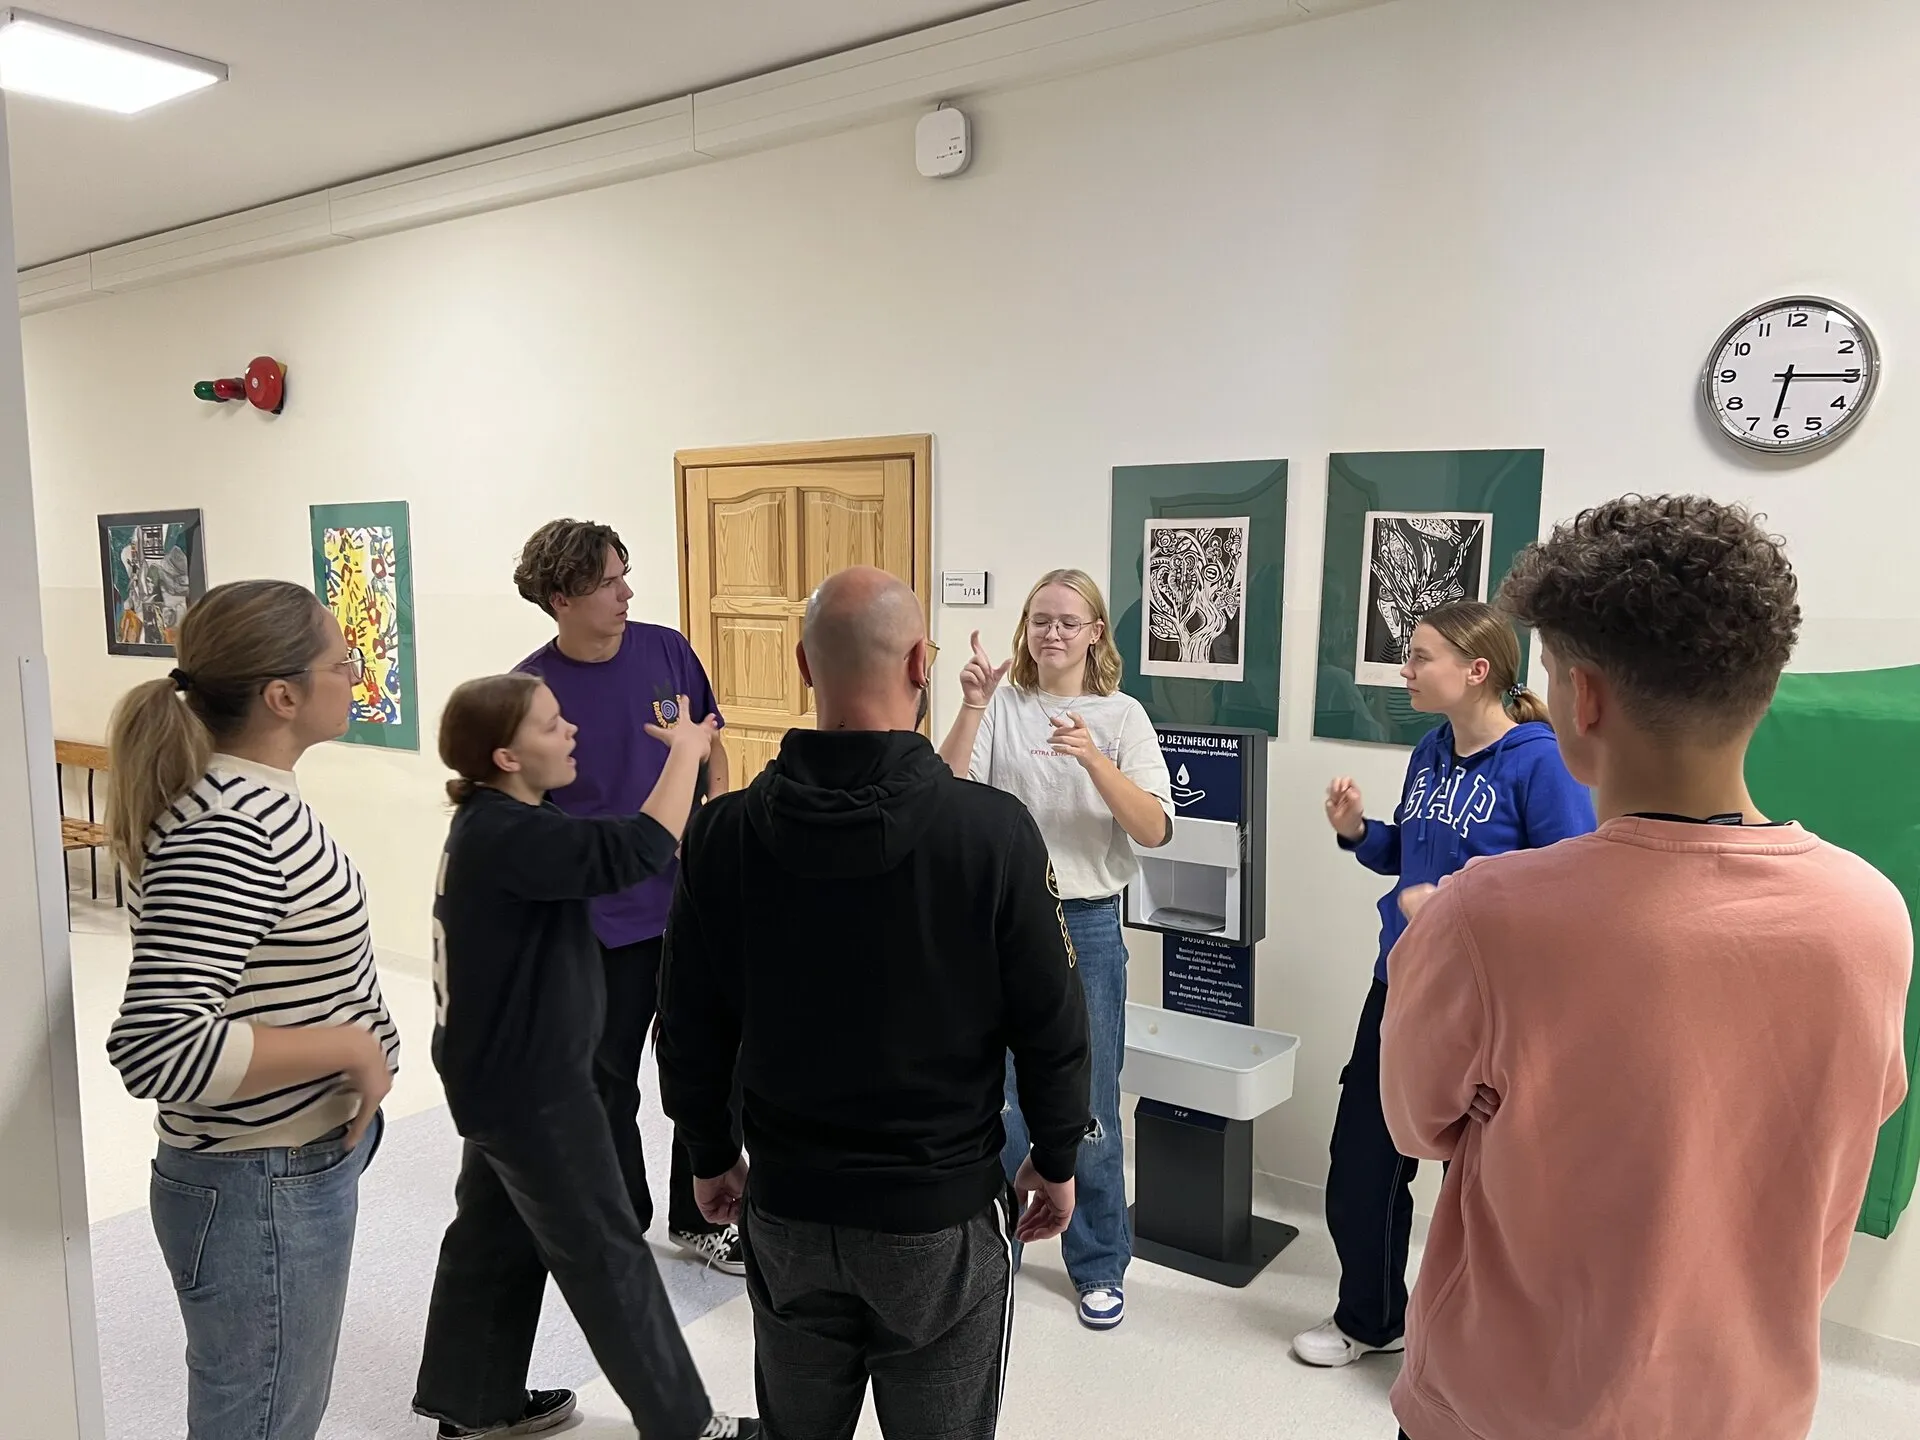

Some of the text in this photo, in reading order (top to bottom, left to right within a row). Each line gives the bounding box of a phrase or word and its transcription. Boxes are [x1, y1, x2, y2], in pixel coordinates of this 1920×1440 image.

[1788, 313, 1808, 327] 12
[1825, 320, 1830, 333] 1
[1758, 323, 1771, 337] 11
[1734, 342, 1751, 356] 10
[1837, 340, 1855, 354] 2
[1720, 369, 1737, 383] 9
[1843, 368, 1861, 383] 3
[1726, 396, 1744, 410] 8
[1830, 395, 1846, 410] 4
[1746, 417, 1760, 431] 7
[1773, 424, 1790, 438] 6
[1804, 417, 1822, 431] 5
[964, 588, 981, 596] 1/14
[1159, 734, 1239, 750] O DEZYNFEKCJI RĄK
[1401, 764, 1496, 839] GAP
